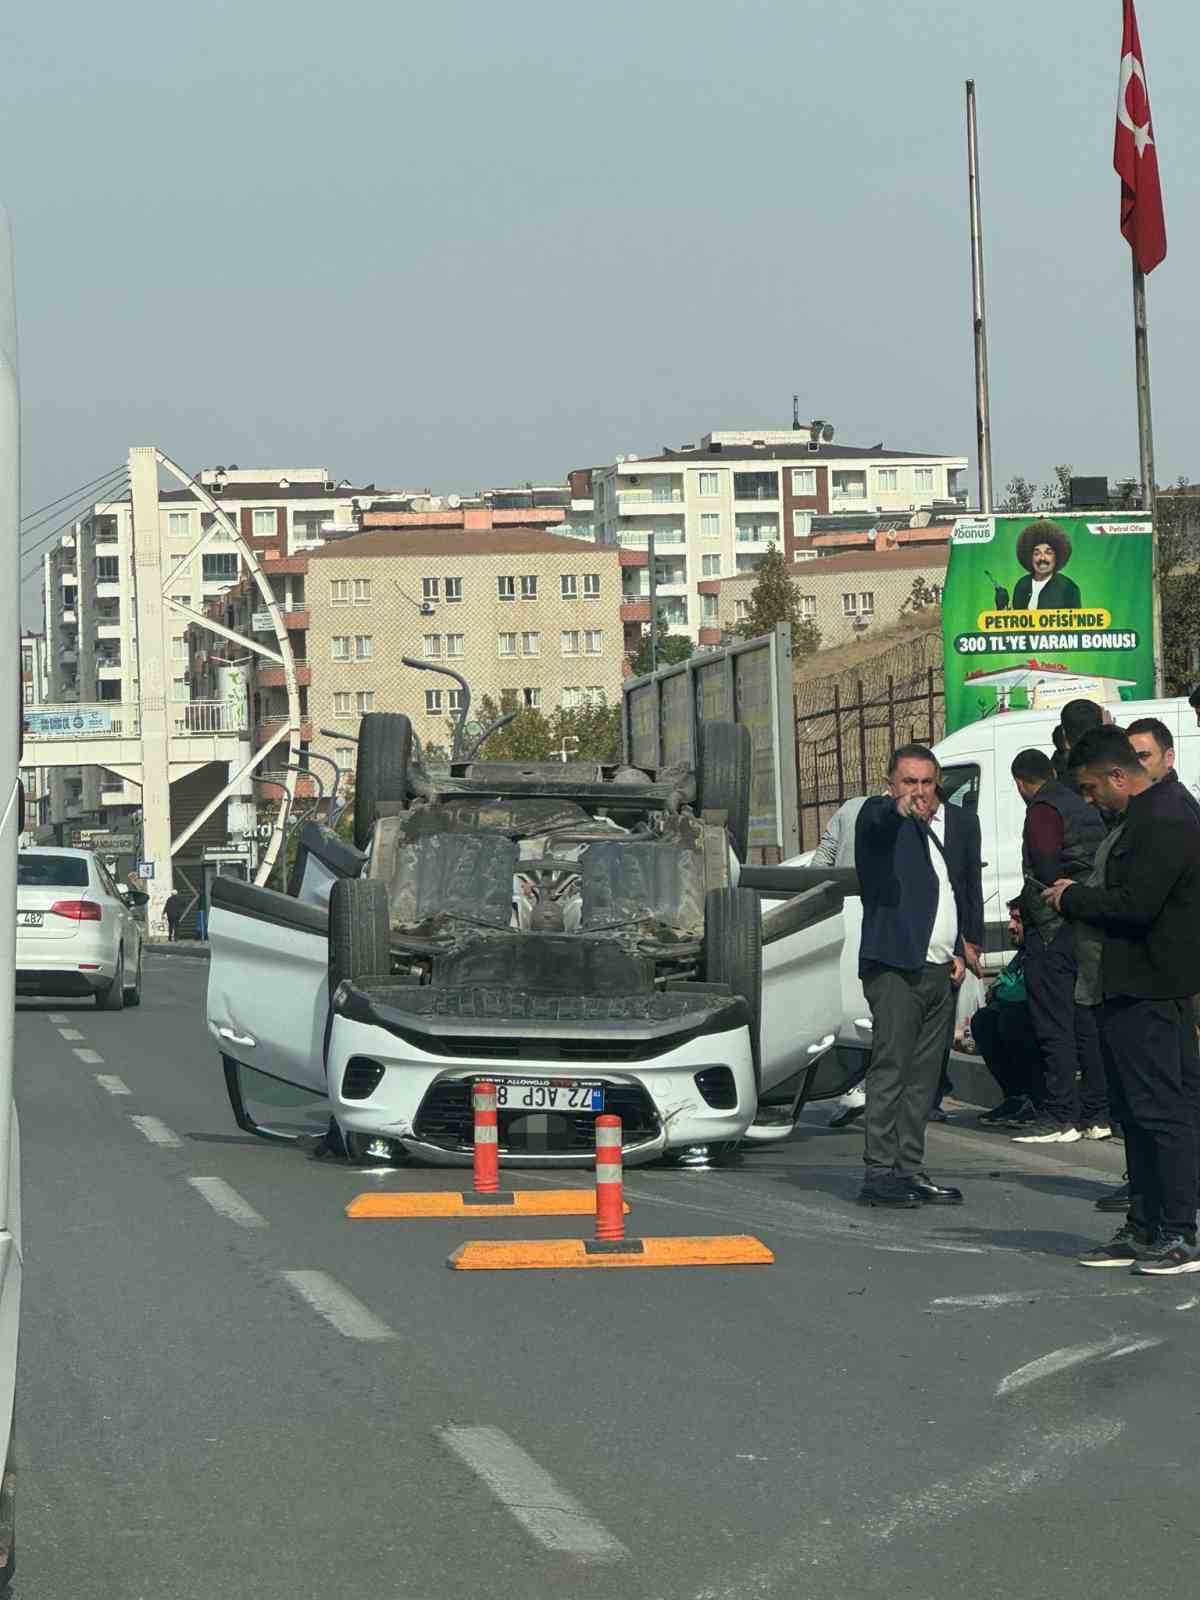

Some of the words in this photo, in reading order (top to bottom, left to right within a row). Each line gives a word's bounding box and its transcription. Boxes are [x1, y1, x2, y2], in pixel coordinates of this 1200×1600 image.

[958, 527, 991, 539] bonus
[984, 612, 1036, 629] PETROL
[1039, 609, 1105, 627] OFİSİ'NDE
[959, 637, 987, 652] 300
[989, 635, 1028, 651] TL'YE
[1029, 635, 1079, 650] VARAN
[1081, 633, 1137, 649] BONUS!
[497, 1085, 509, 1106] 8
[522, 1086, 559, 1108] ACP
[567, 1087, 592, 1108] 72
